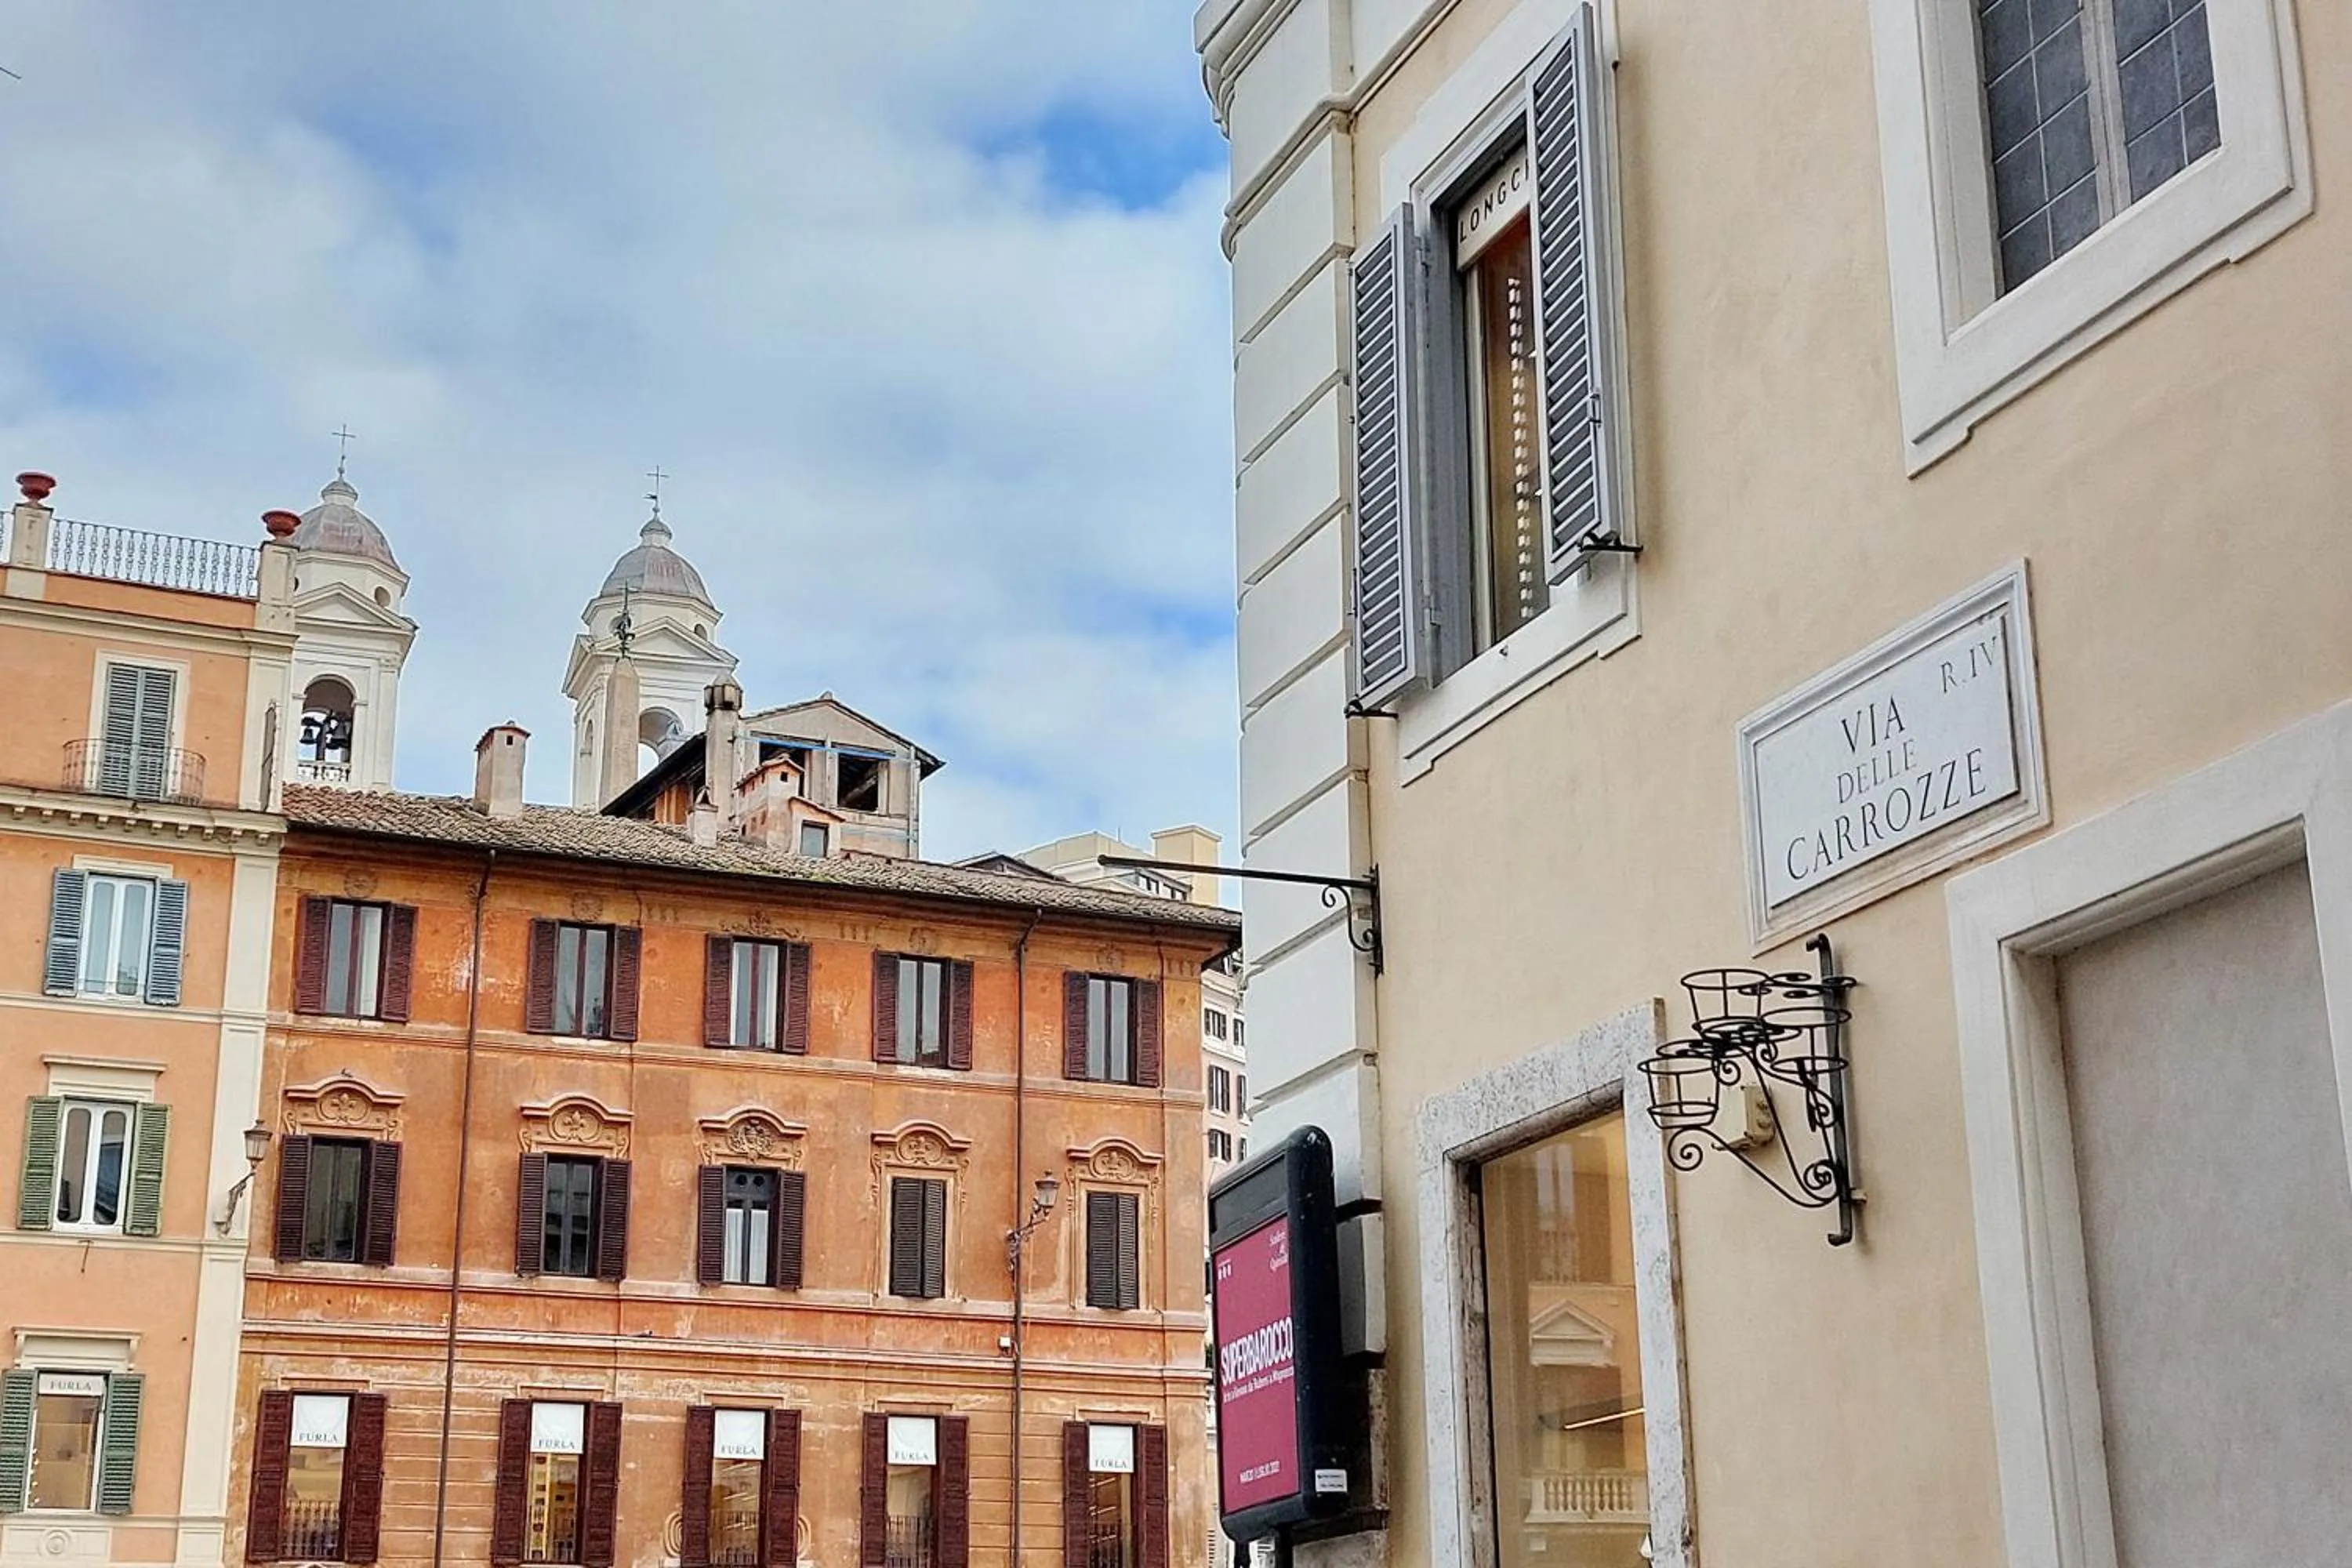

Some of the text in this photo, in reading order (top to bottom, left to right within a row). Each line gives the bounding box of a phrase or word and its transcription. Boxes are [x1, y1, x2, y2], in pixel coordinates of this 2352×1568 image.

[1841, 694, 1906, 753] VIA
[1837, 739, 1918, 804] DELLE
[1786, 748, 1987, 880] CARROZZE
[1221, 1316, 1293, 1387] SUPERBAROCCO
[49, 1381, 92, 1391] FURLA
[299, 1432, 338, 1443] FURLA
[539, 1439, 575, 1449] FURLA
[721, 1445, 756, 1455] FURLA
[1095, 1458, 1127, 1468] FURLA
